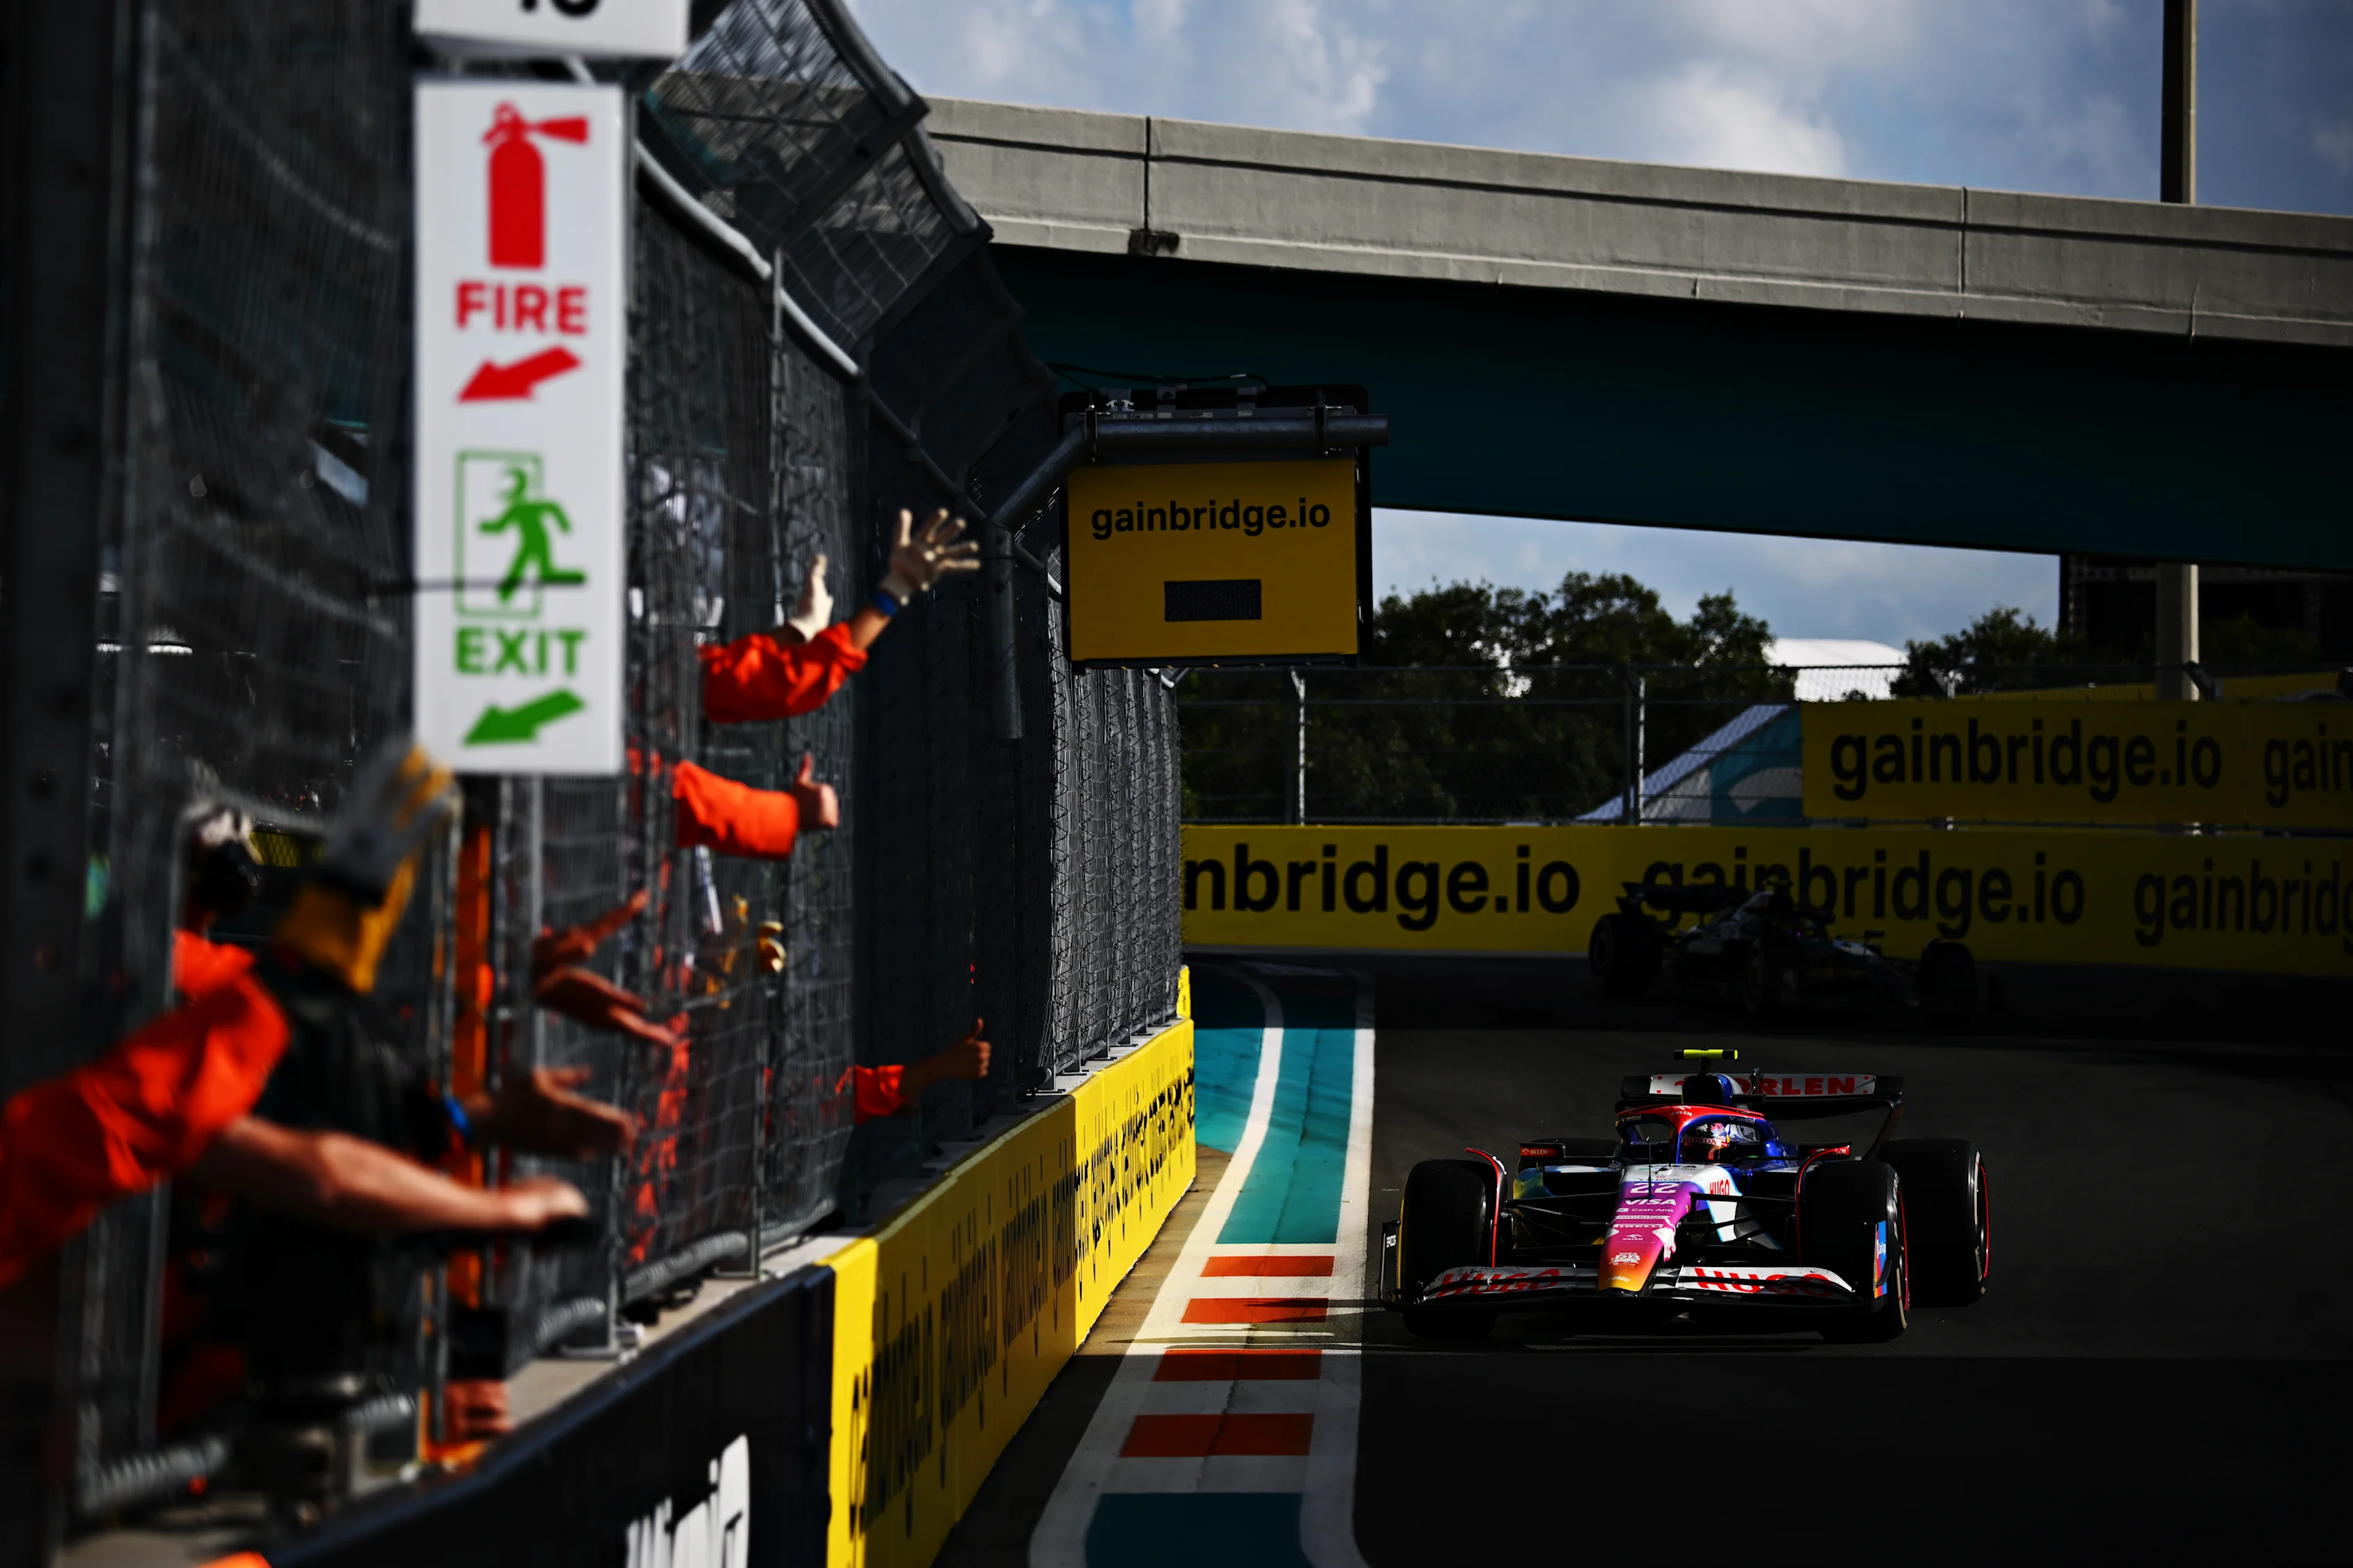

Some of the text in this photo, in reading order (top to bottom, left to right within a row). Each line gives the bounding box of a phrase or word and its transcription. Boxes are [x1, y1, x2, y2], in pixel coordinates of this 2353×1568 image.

[455, 280, 587, 335] FIRE
[1092, 498, 1330, 540] gainbridge.io
[456, 627, 585, 676] EXIT
[1831, 718, 2222, 802] gainbridge.io
[1630, 1182, 1679, 1194] 22
[1694, 1268, 1833, 1297] HUGO
